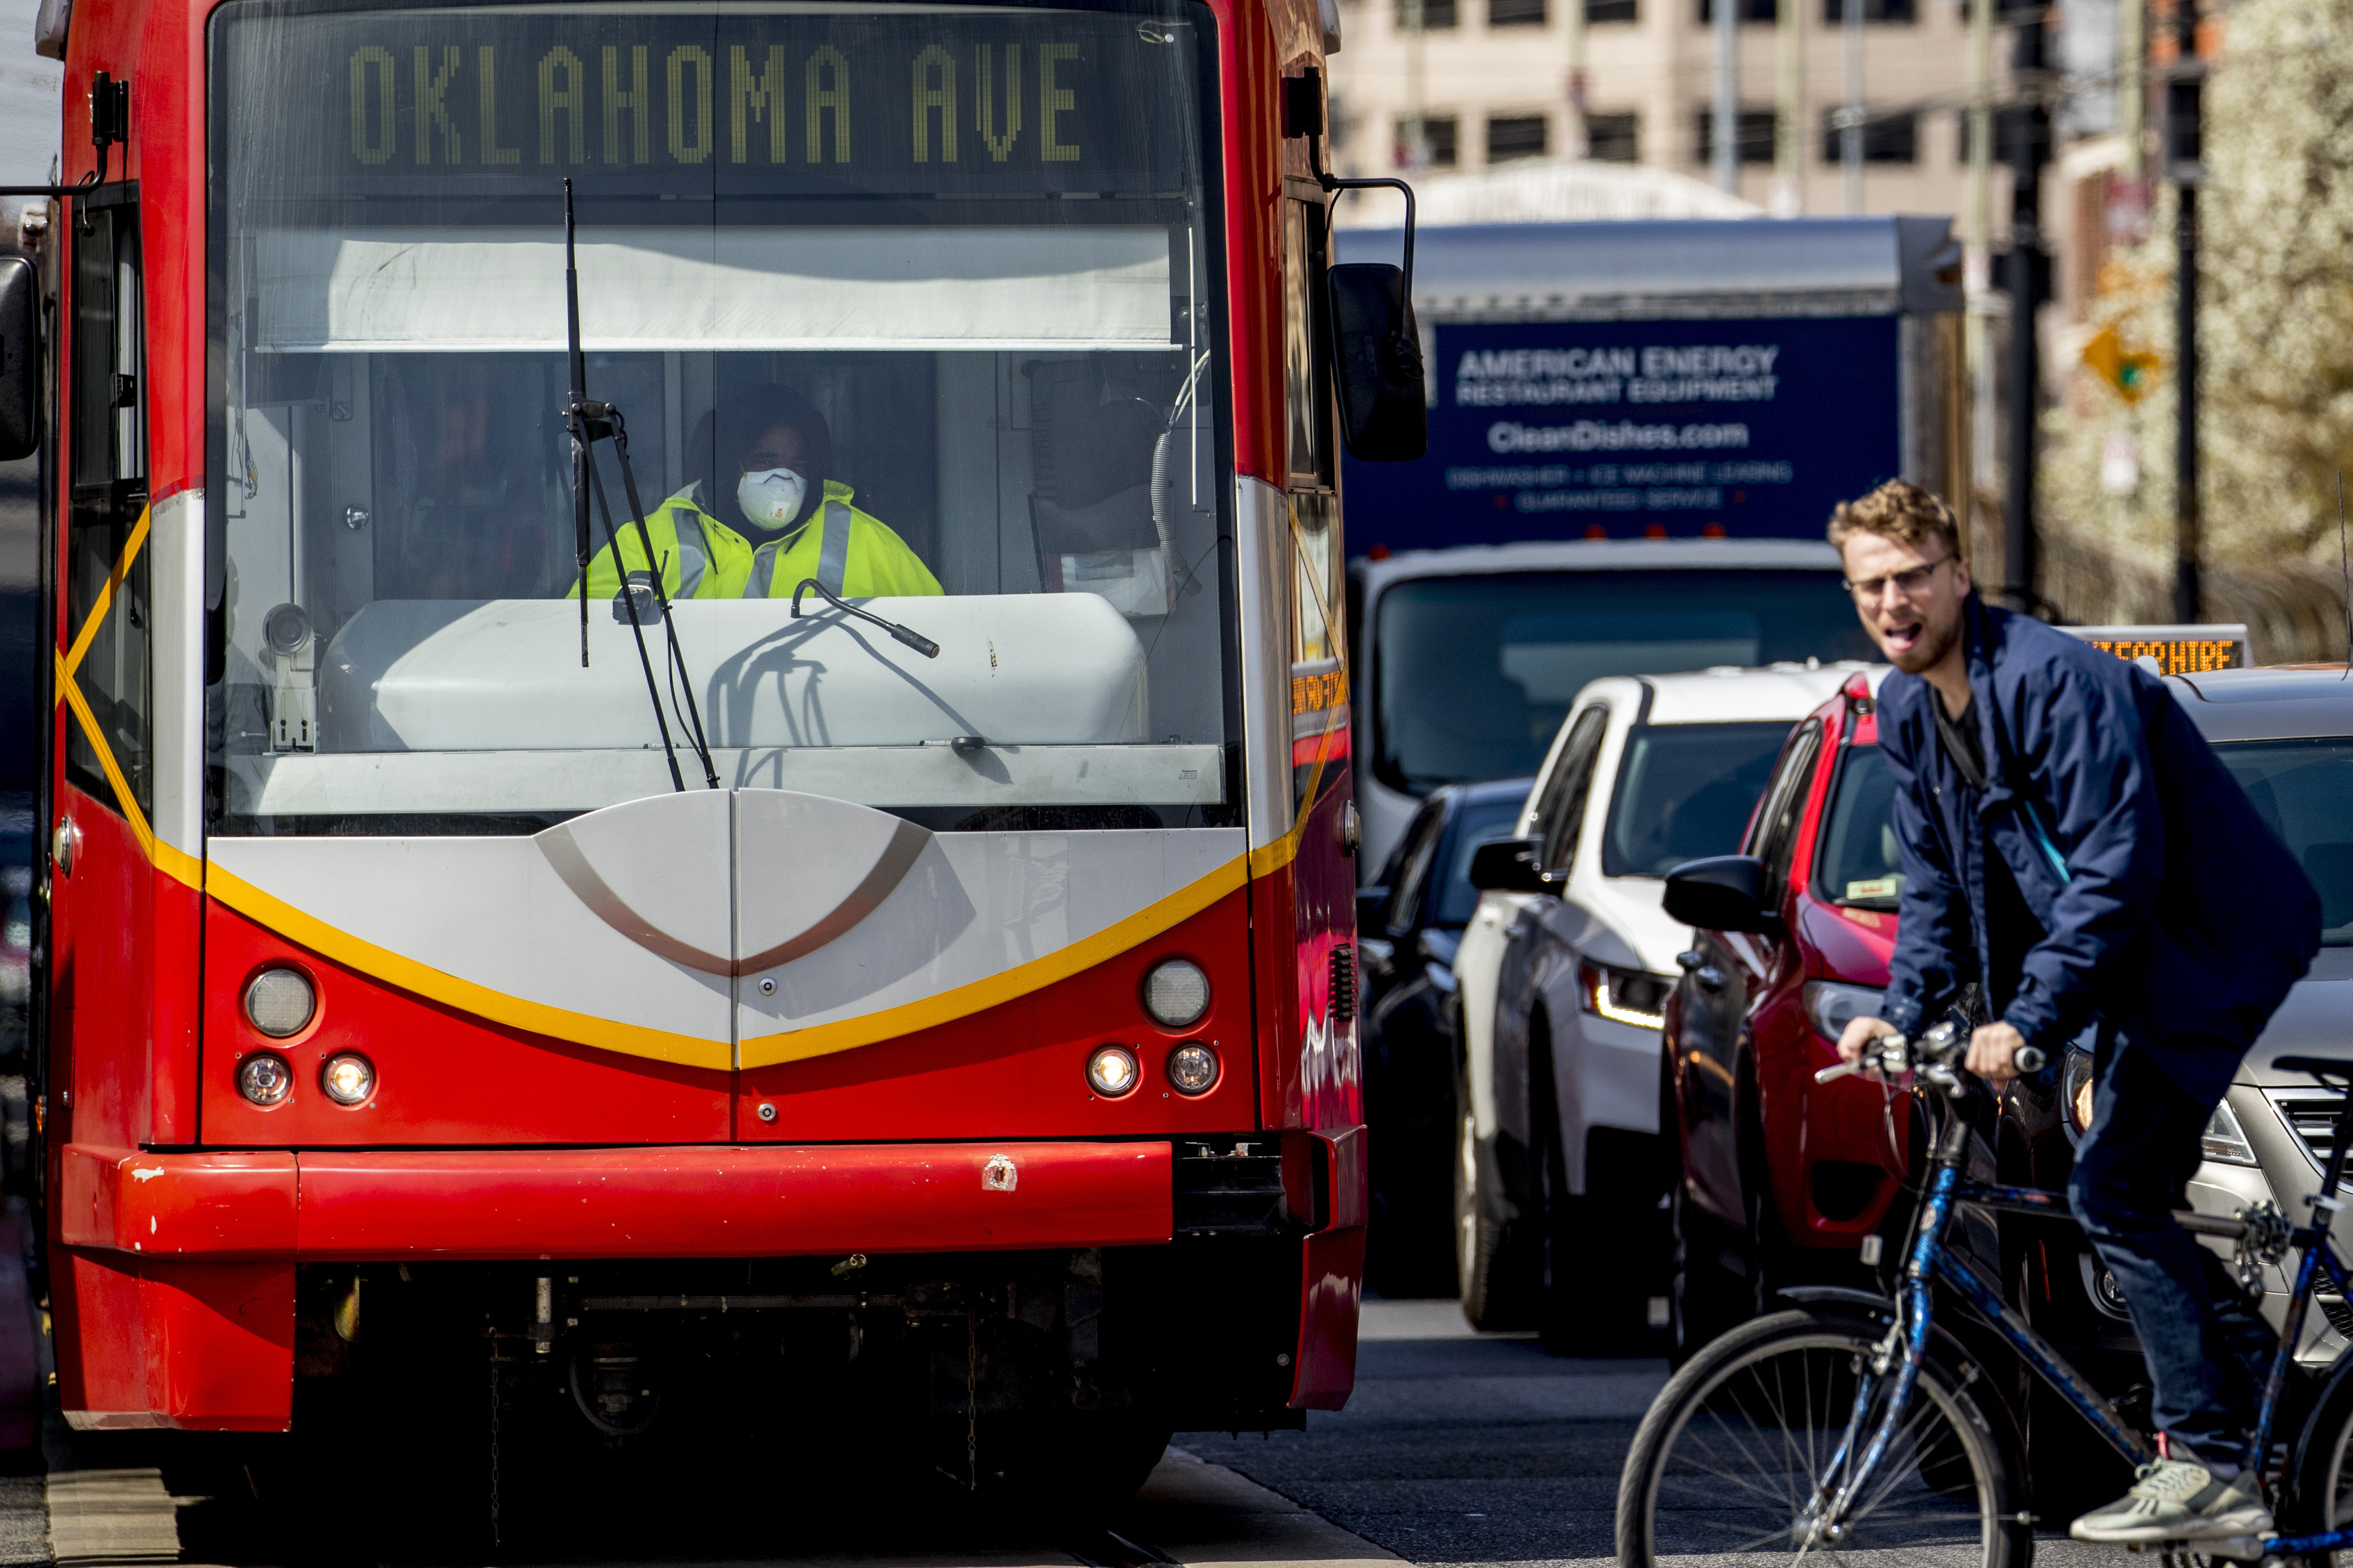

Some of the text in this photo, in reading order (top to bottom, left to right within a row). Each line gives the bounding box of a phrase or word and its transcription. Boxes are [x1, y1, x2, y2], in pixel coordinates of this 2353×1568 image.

[349, 43, 1080, 165] OKLAHOMA AVE
[1457, 345, 1779, 379] AMERICAN ENERGY
[1456, 376, 1778, 405] RESTAURANT EQUIPMENT
[1487, 420, 1749, 452] CleanDishes.com
